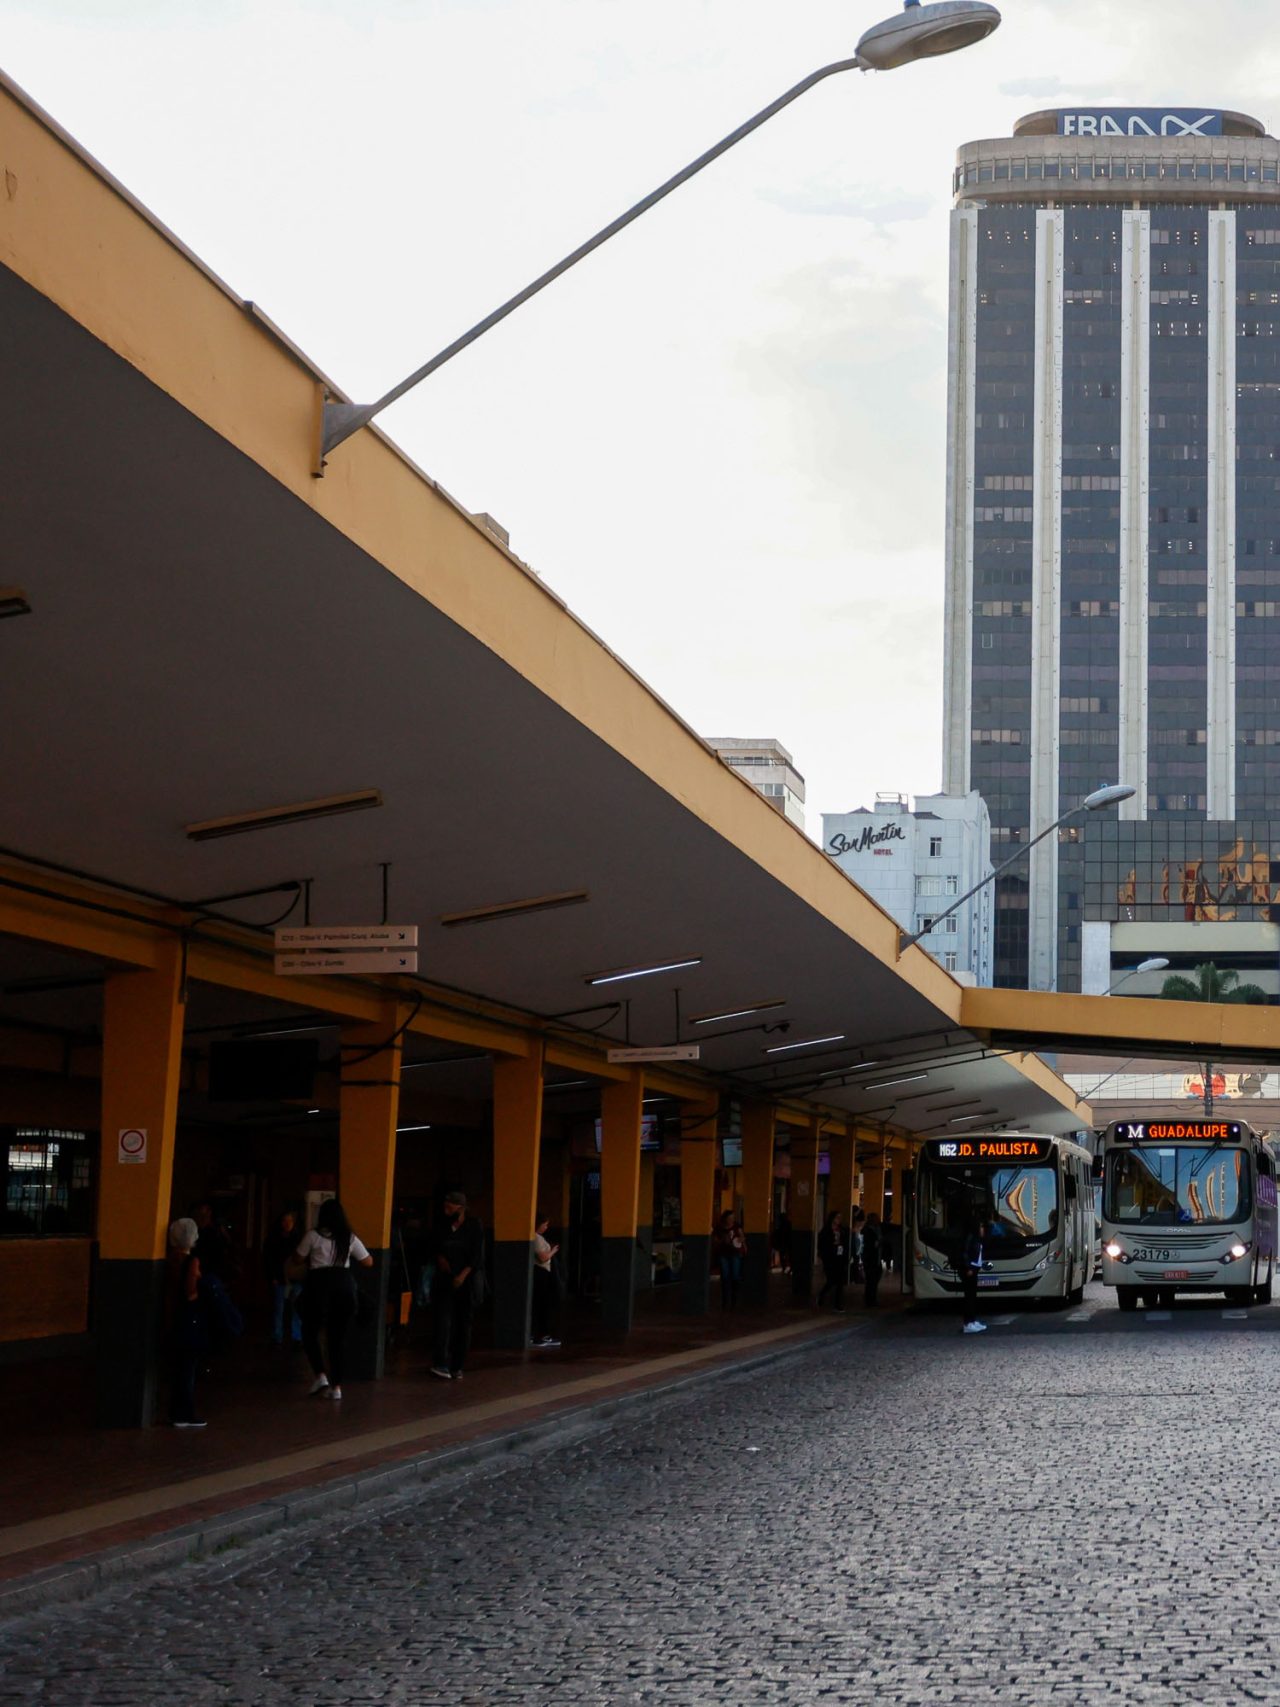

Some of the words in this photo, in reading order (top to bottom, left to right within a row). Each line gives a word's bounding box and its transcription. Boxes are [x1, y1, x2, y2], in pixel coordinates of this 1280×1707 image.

[824, 834, 859, 856] San
[857, 823, 905, 852] Martin
[1128, 1125, 1144, 1138] M
[1149, 1125, 1228, 1138] GUADALUPE
[958, 1144, 975, 1156] JD.
[980, 1143, 1038, 1156] PAULISTA
[1133, 1249, 1170, 1260] 23179
